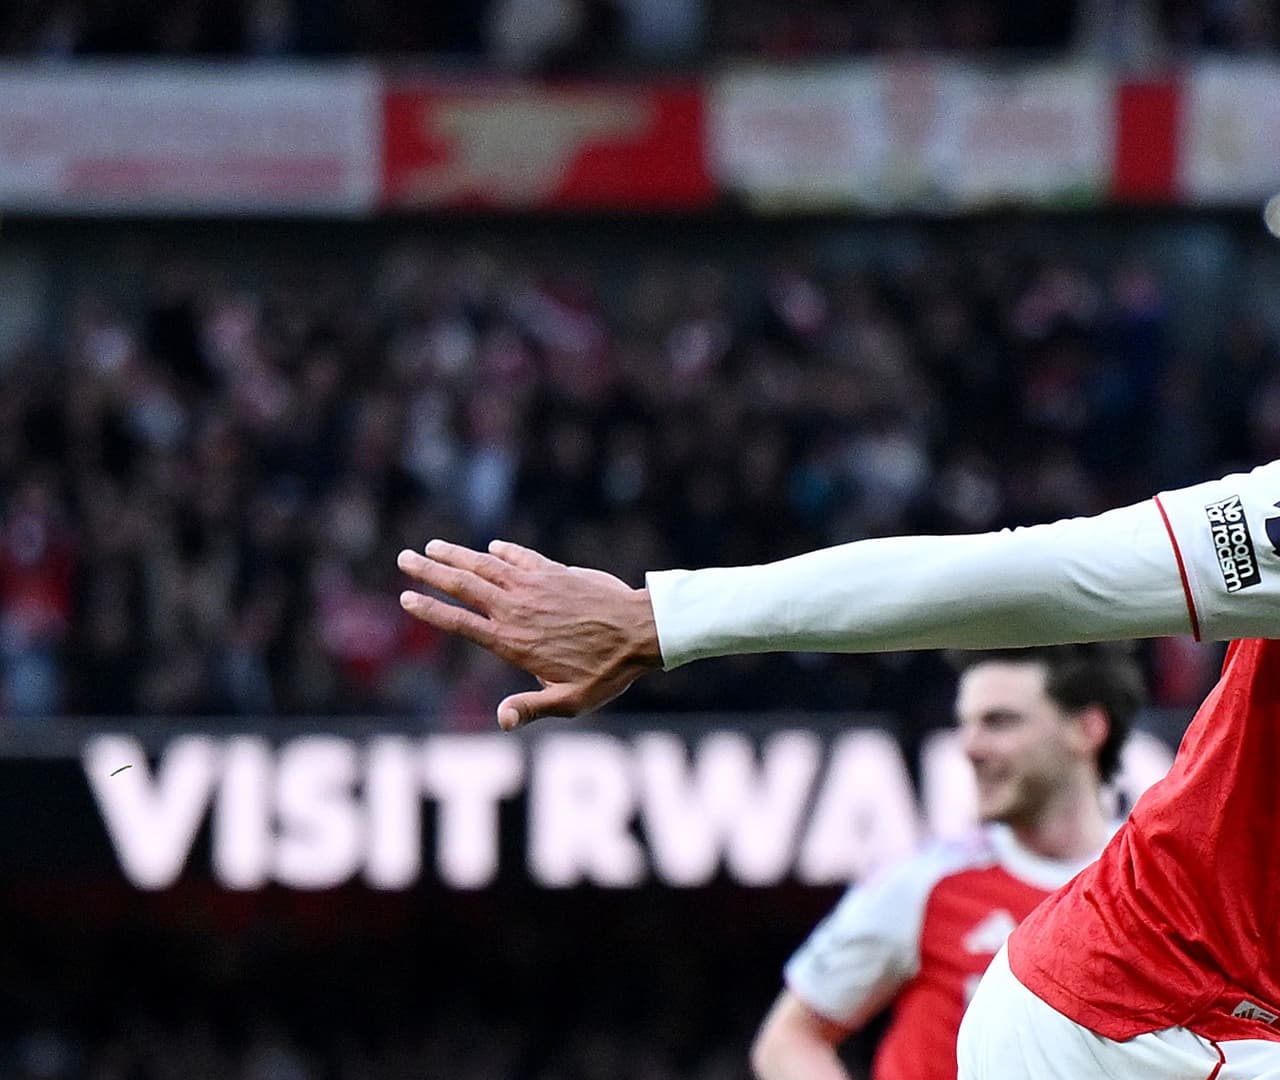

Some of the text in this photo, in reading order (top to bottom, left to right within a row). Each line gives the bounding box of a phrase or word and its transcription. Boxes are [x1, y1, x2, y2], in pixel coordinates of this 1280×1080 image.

[1212, 525, 1242, 592] racism
[1223, 495, 1254, 578] No room
